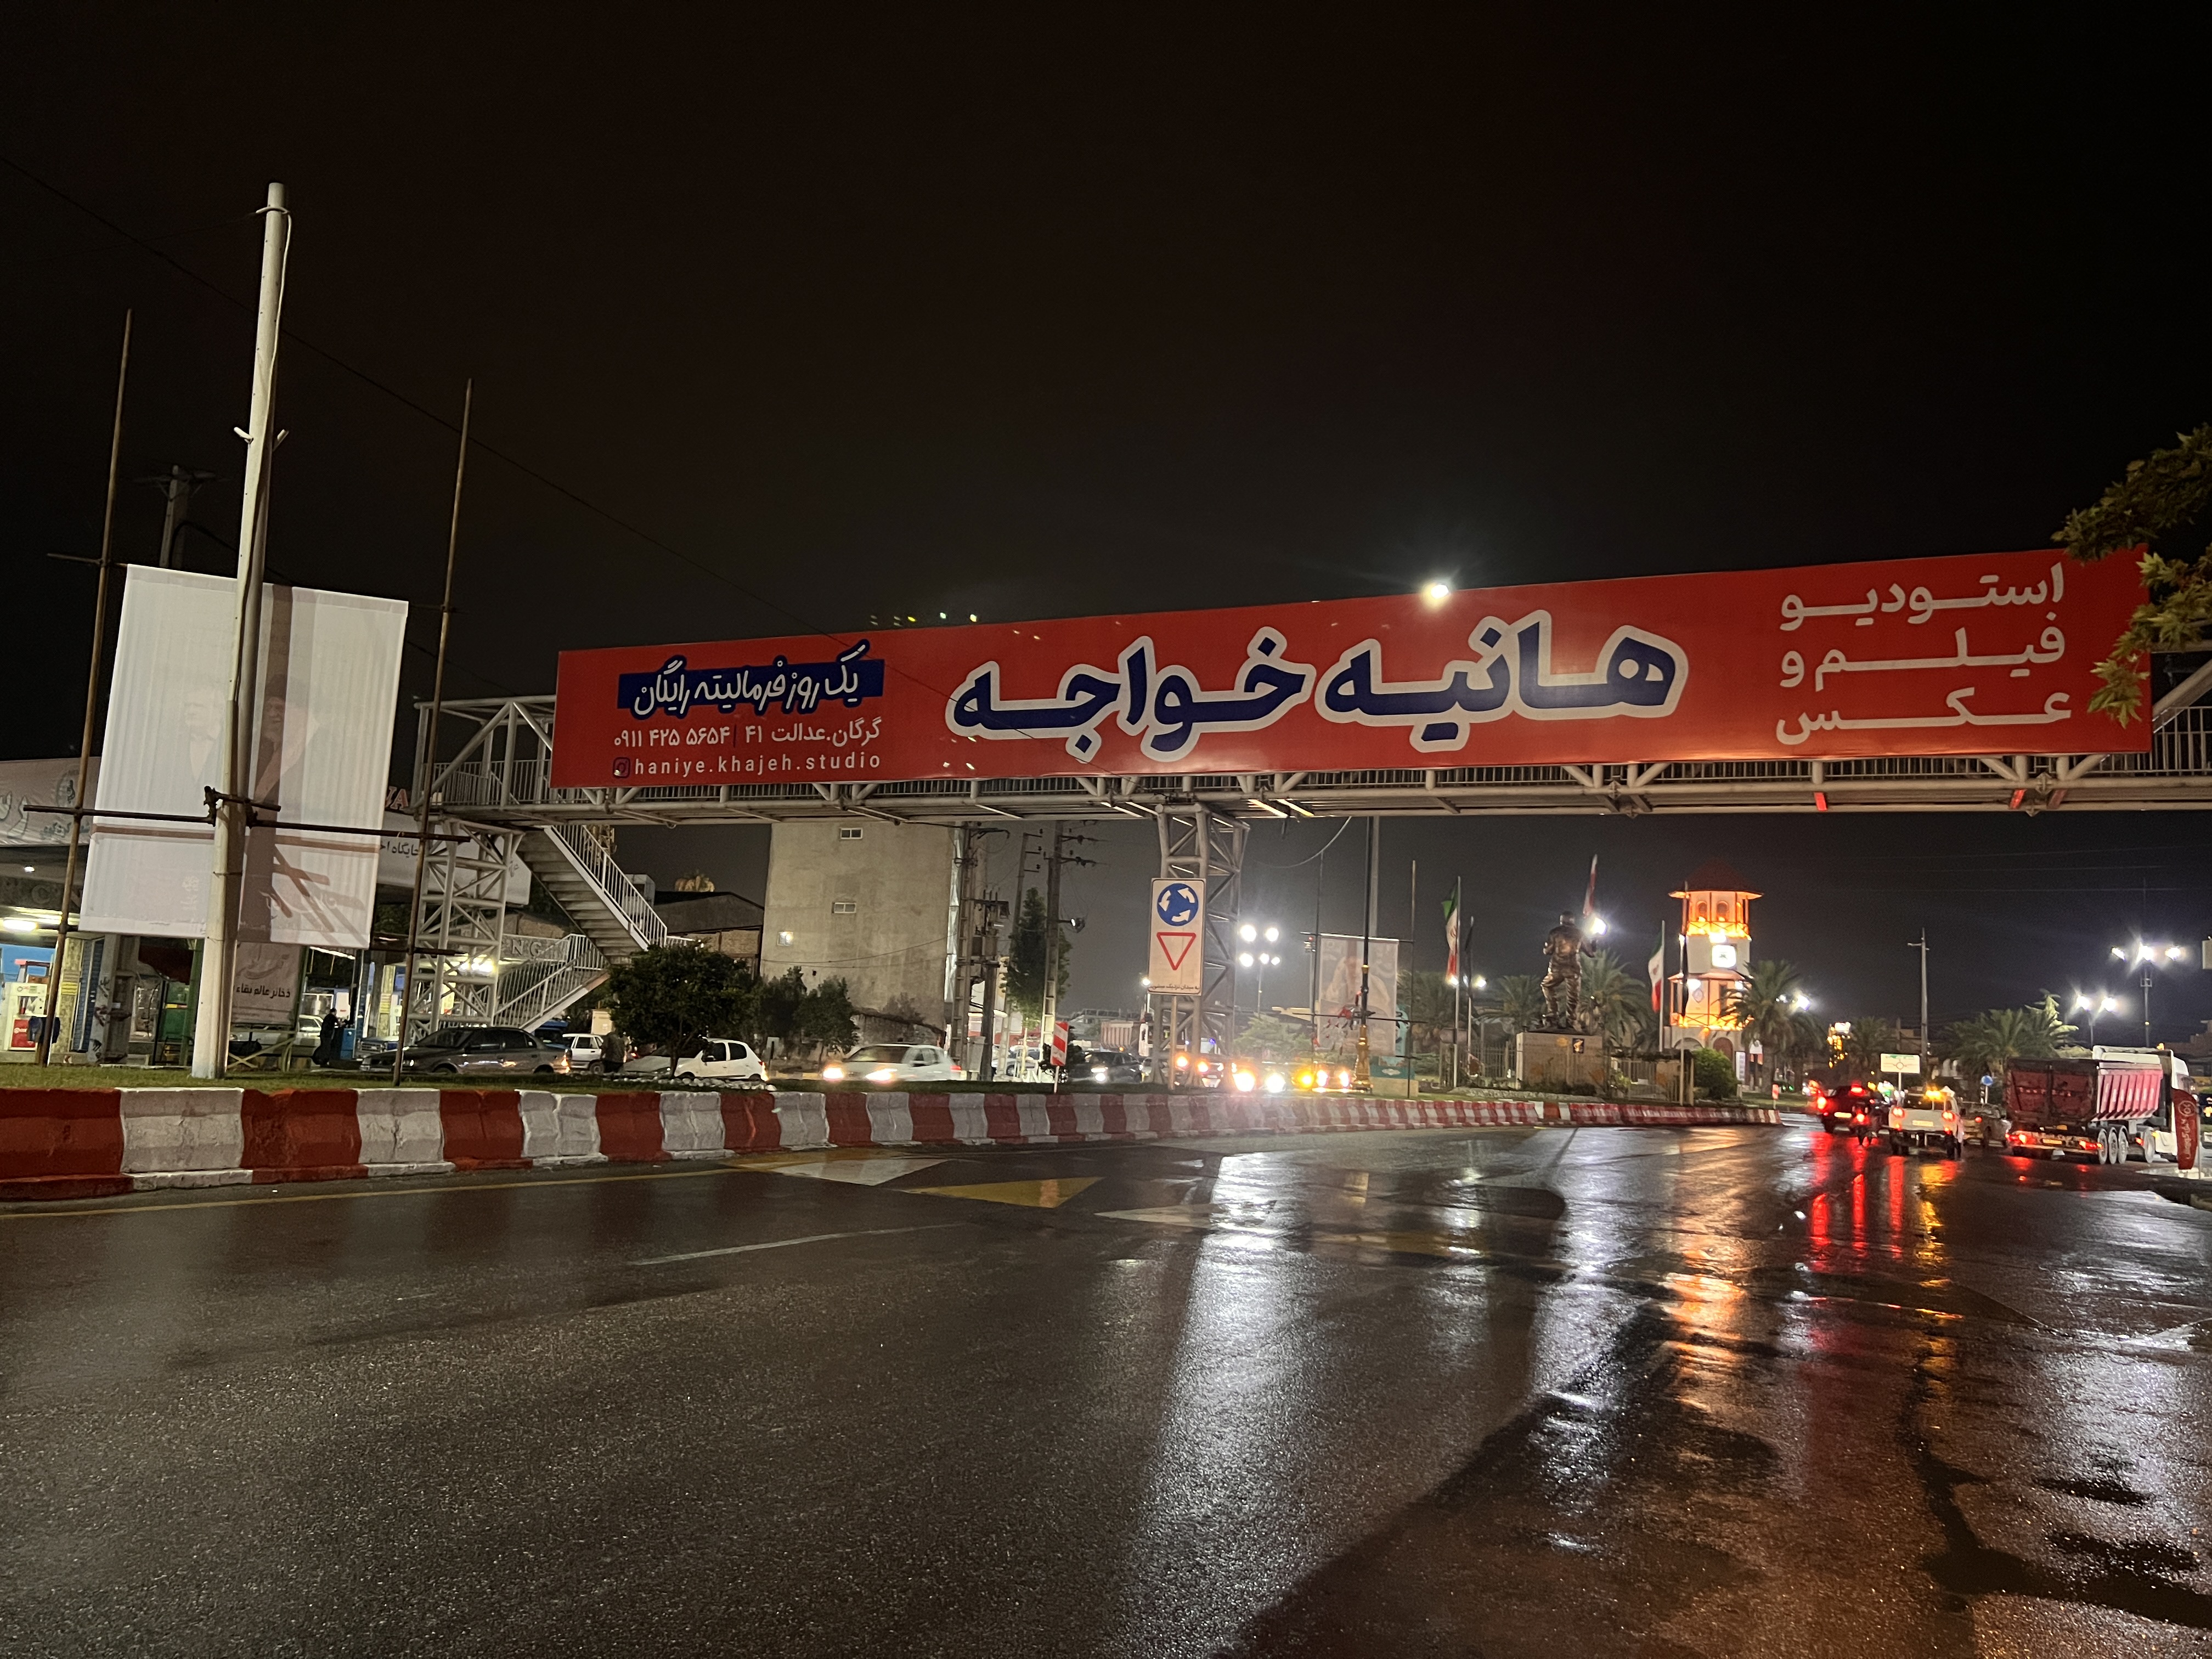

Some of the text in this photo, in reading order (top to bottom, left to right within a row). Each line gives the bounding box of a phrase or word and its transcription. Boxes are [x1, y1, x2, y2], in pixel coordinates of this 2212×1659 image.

[1780, 561, 2064, 631] استودیو
[634, 644, 866, 715] یک روز فرمالیته رایگان
[1779, 612, 2066, 691] فیلم و
[946, 612, 1688, 761] هانیه خواجه
[1775, 686, 2072, 745] عکس
[614, 726, 730, 747] ۰۹۱۱ ۴۲۵ ۵۶۵۴
[745, 725, 763, 743] ۴۱
[635, 751, 880, 777] haniye.khajeh.studio
[511, 939, 542, 958] NG
